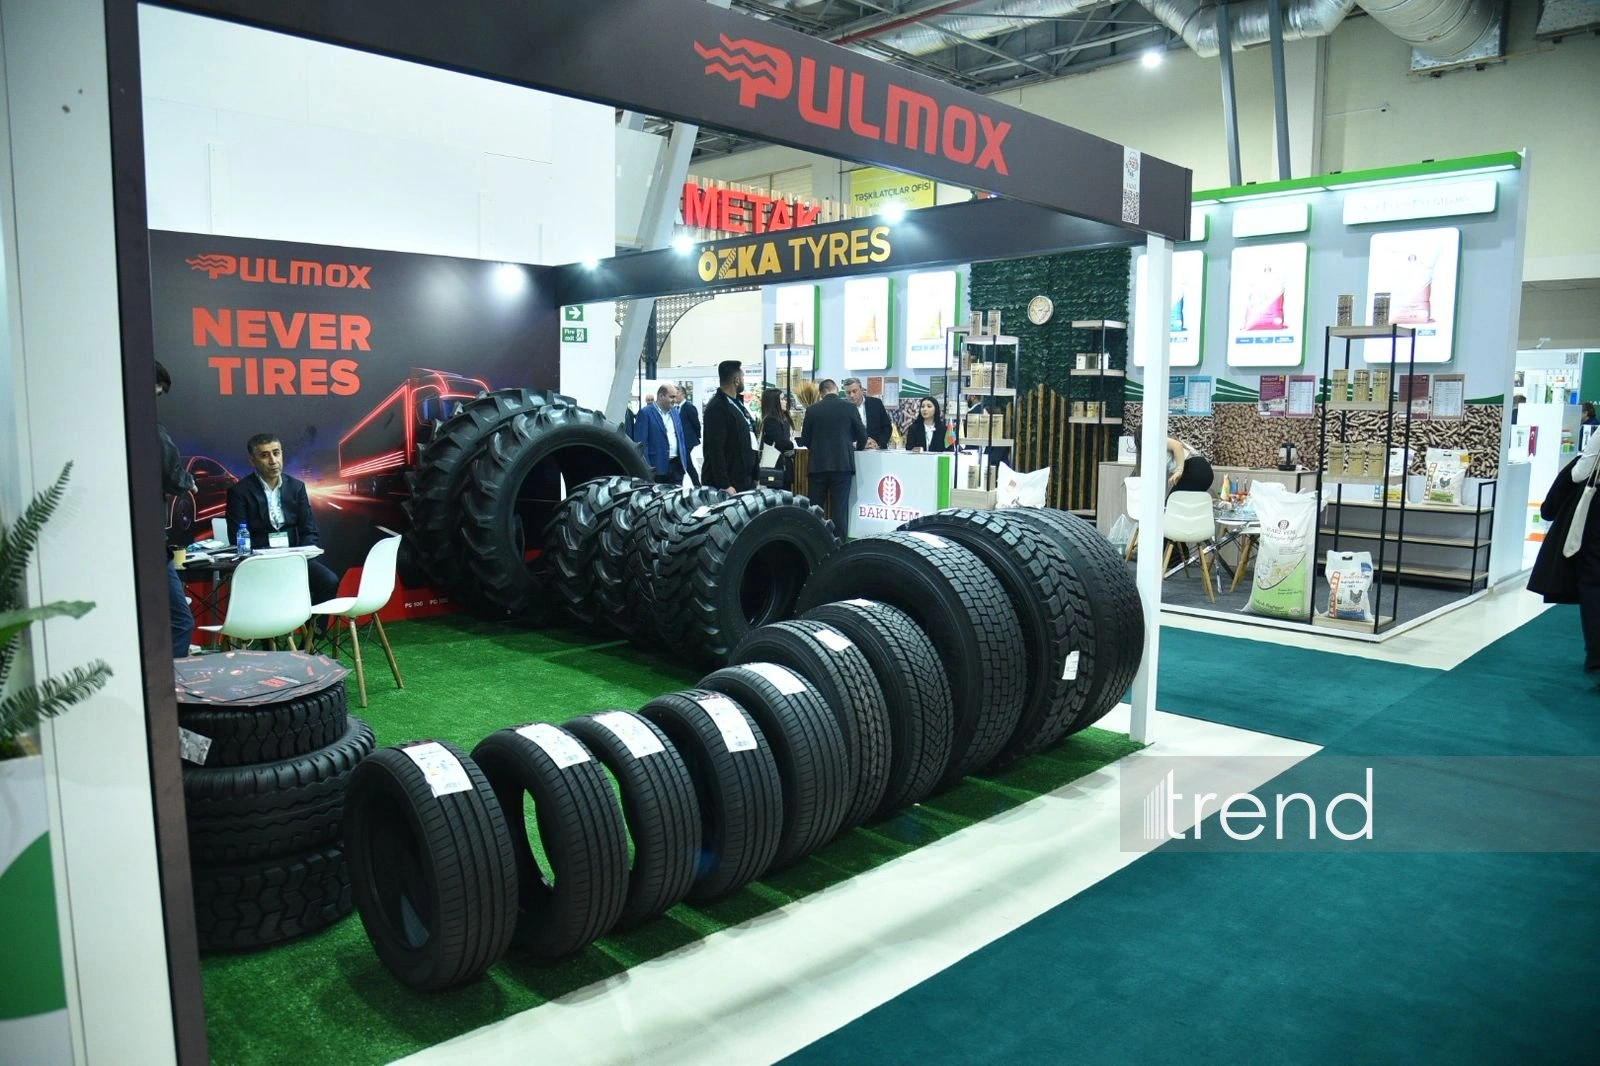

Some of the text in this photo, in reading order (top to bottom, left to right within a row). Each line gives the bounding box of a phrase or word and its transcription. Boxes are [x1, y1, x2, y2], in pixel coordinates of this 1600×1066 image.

[694, 32, 1012, 176] PULMOX
[185, 253, 373, 290] PULMOX
[697, 226, 891, 282] ÖZKA TYRES
[192, 307, 372, 352] NEVER
[208, 356, 361, 397] TIRES
[859, 506, 889, 520] BAKI
